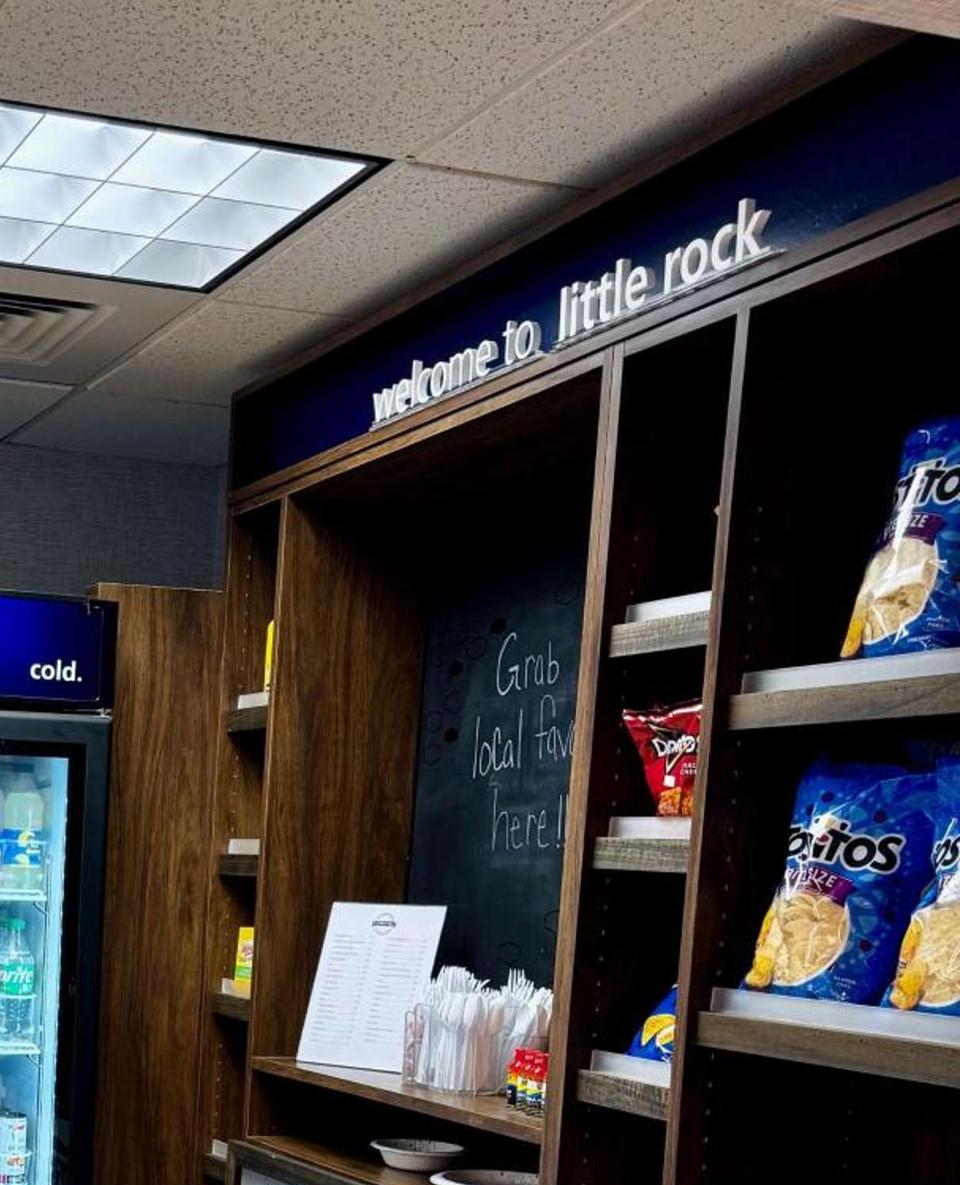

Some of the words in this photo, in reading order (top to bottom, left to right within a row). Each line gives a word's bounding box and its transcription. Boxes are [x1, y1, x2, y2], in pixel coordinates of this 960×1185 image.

[373, 340, 499, 423] welcome
[502, 320, 541, 365] to
[558, 258, 655, 343] little
[664, 198, 772, 295] rock
[30, 660, 82, 683] cold.
[496, 632, 560, 696] Grab
[472, 708, 524, 779] local
